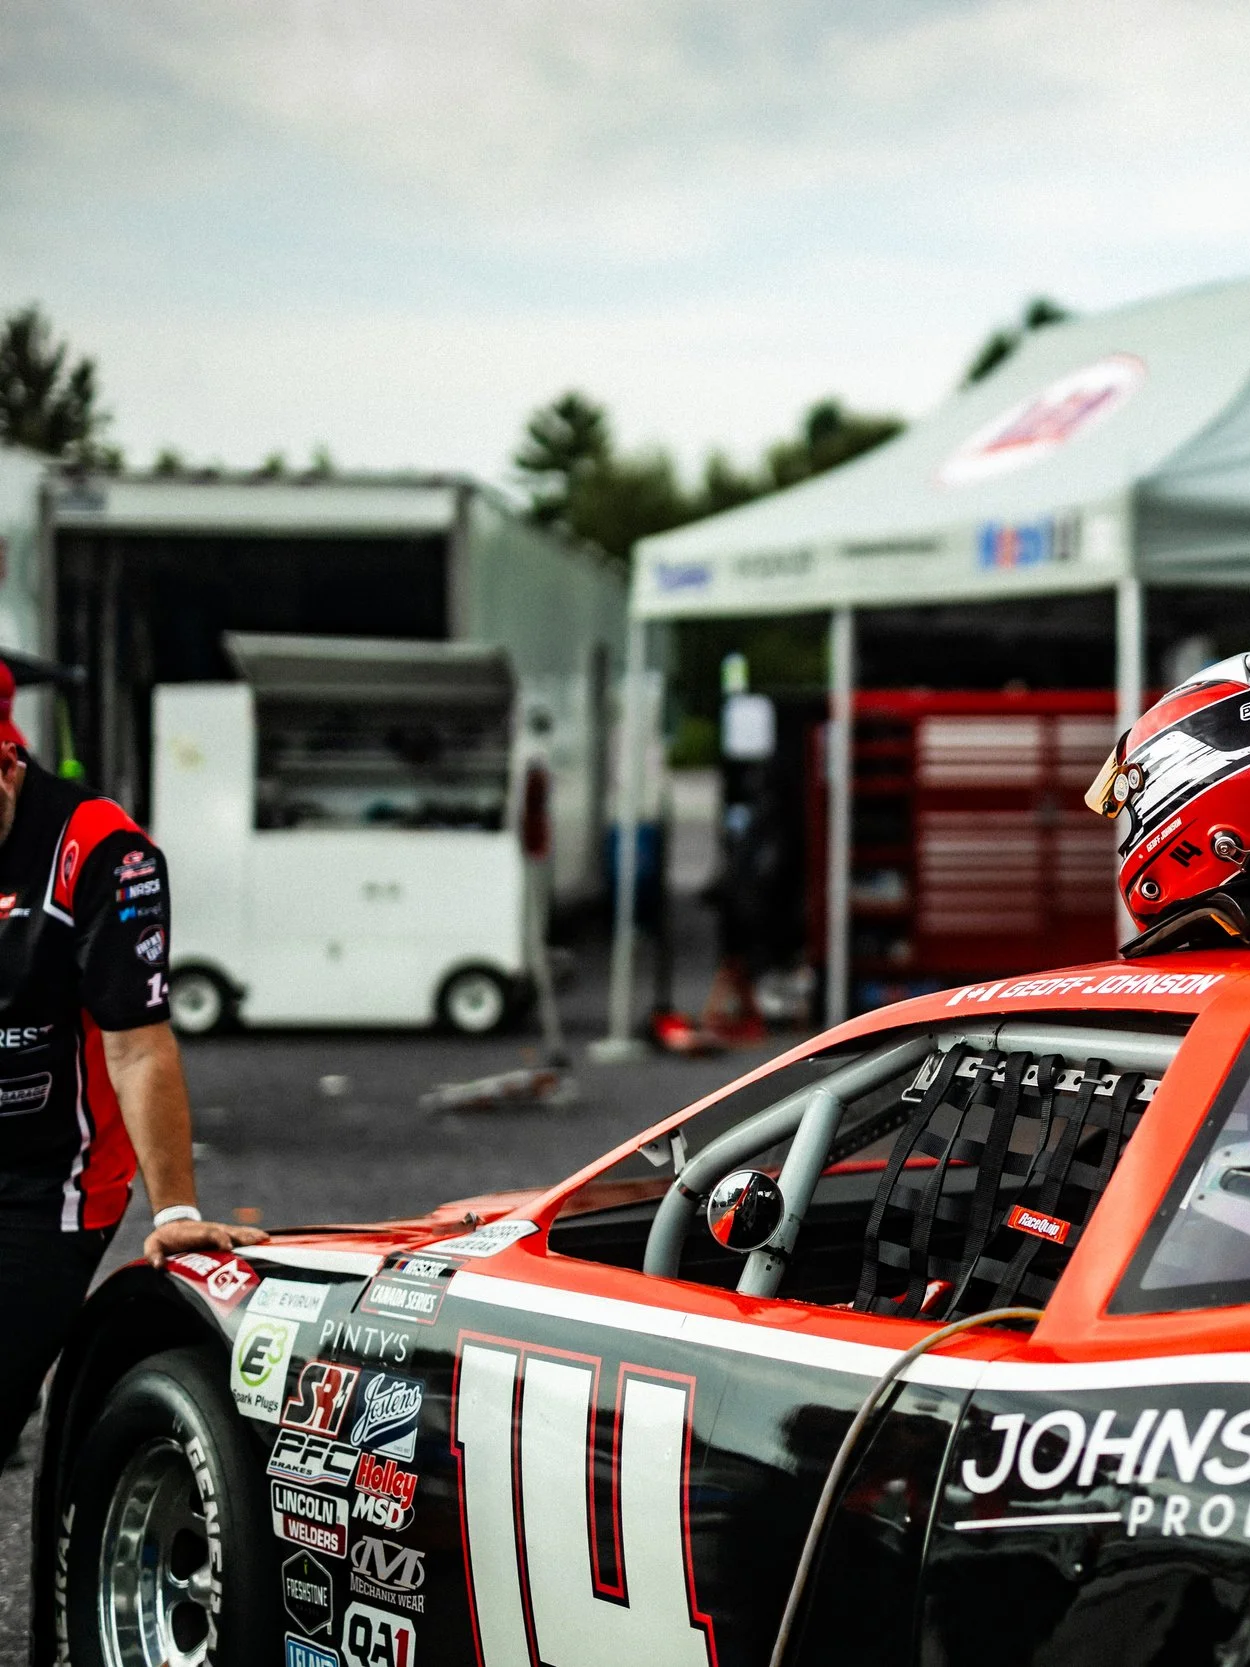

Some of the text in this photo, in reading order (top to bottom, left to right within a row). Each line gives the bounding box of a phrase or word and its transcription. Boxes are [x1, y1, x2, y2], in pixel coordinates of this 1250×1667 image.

[1169, 840, 1203, 868] 14
[998, 974, 1225, 999] GEOFF JOHNSON
[1018, 1212, 1060, 1237] RaceQuip
[401, 1258, 448, 1279] NASCAR
[370, 1284, 437, 1313] CANADA SERIES
[319, 1319, 409, 1363] PINTY'S
[255, 1394, 278, 1413] Plugs
[270, 1460, 313, 1476] BRAKES
[274, 1431, 359, 1477] PFC
[355, 1453, 418, 1510] Holley
[275, 1487, 334, 1526] LINCOLN
[352, 1492, 405, 1530] MSD
[456, 1343, 712, 1667] 14
[288, 1519, 339, 1552] WELDERS
[350, 1572, 425, 1613] MECHANIX WEAR
